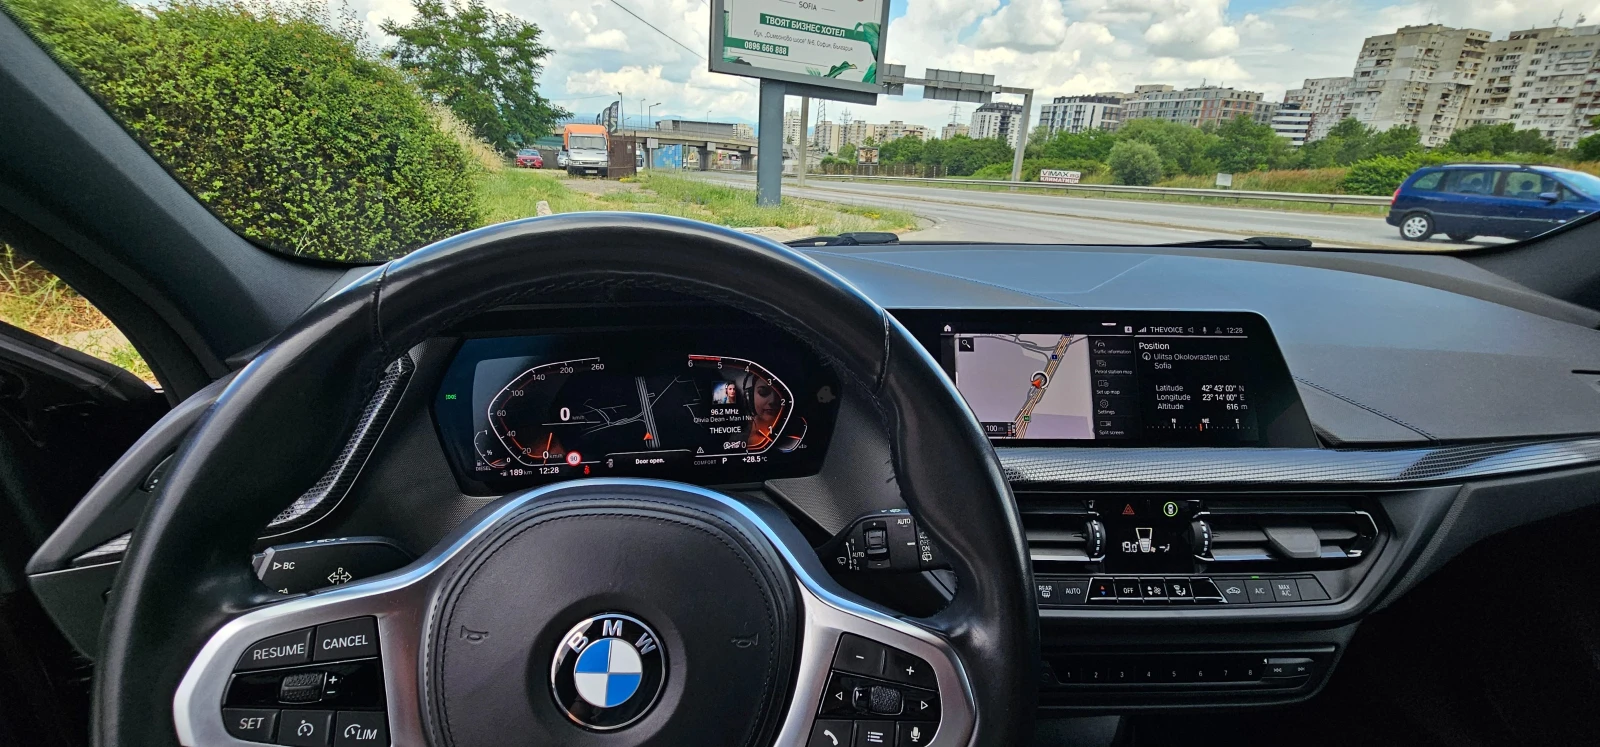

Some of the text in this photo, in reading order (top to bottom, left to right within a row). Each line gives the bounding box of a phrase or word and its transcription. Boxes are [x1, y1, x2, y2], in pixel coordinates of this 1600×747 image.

[799, 1, 817, 11] SOFIA
[765, 16, 846, 38] ТВОЯТ БИЗНЕС ХОТЕЛ
[1150, 326, 1184, 334] THEVOICE
[1139, 342, 1170, 351] Position
[1153, 353, 1173, 361] Ulitsa
[1174, 353, 1219, 361] Okolovrasten
[1155, 362, 1172, 370] Sofia
[1156, 384, 1184, 392] Latitude
[1157, 393, 1191, 402] Longitude
[1226, 403, 1239, 411] 616
[560, 407, 571, 422] 0
[724, 408, 739, 416] MHz
[709, 426, 742, 435] THEVOICE
[768, 426, 773, 434] 1
[986, 425, 998, 433] 100
[522, 447, 532, 455] 20
[542, 450, 549, 460] 0
[635, 457, 665, 466] Door open.
[742, 456, 761, 464] +28.5
[539, 466, 560, 475] 12:28
[282, 561, 296, 570] BC
[567, 619, 658, 656] BMW
[322, 635, 369, 650] CANCEL
[253, 643, 305, 661] RESUME
[239, 717, 265, 730] SET
[356, 729, 378, 740] LIM
